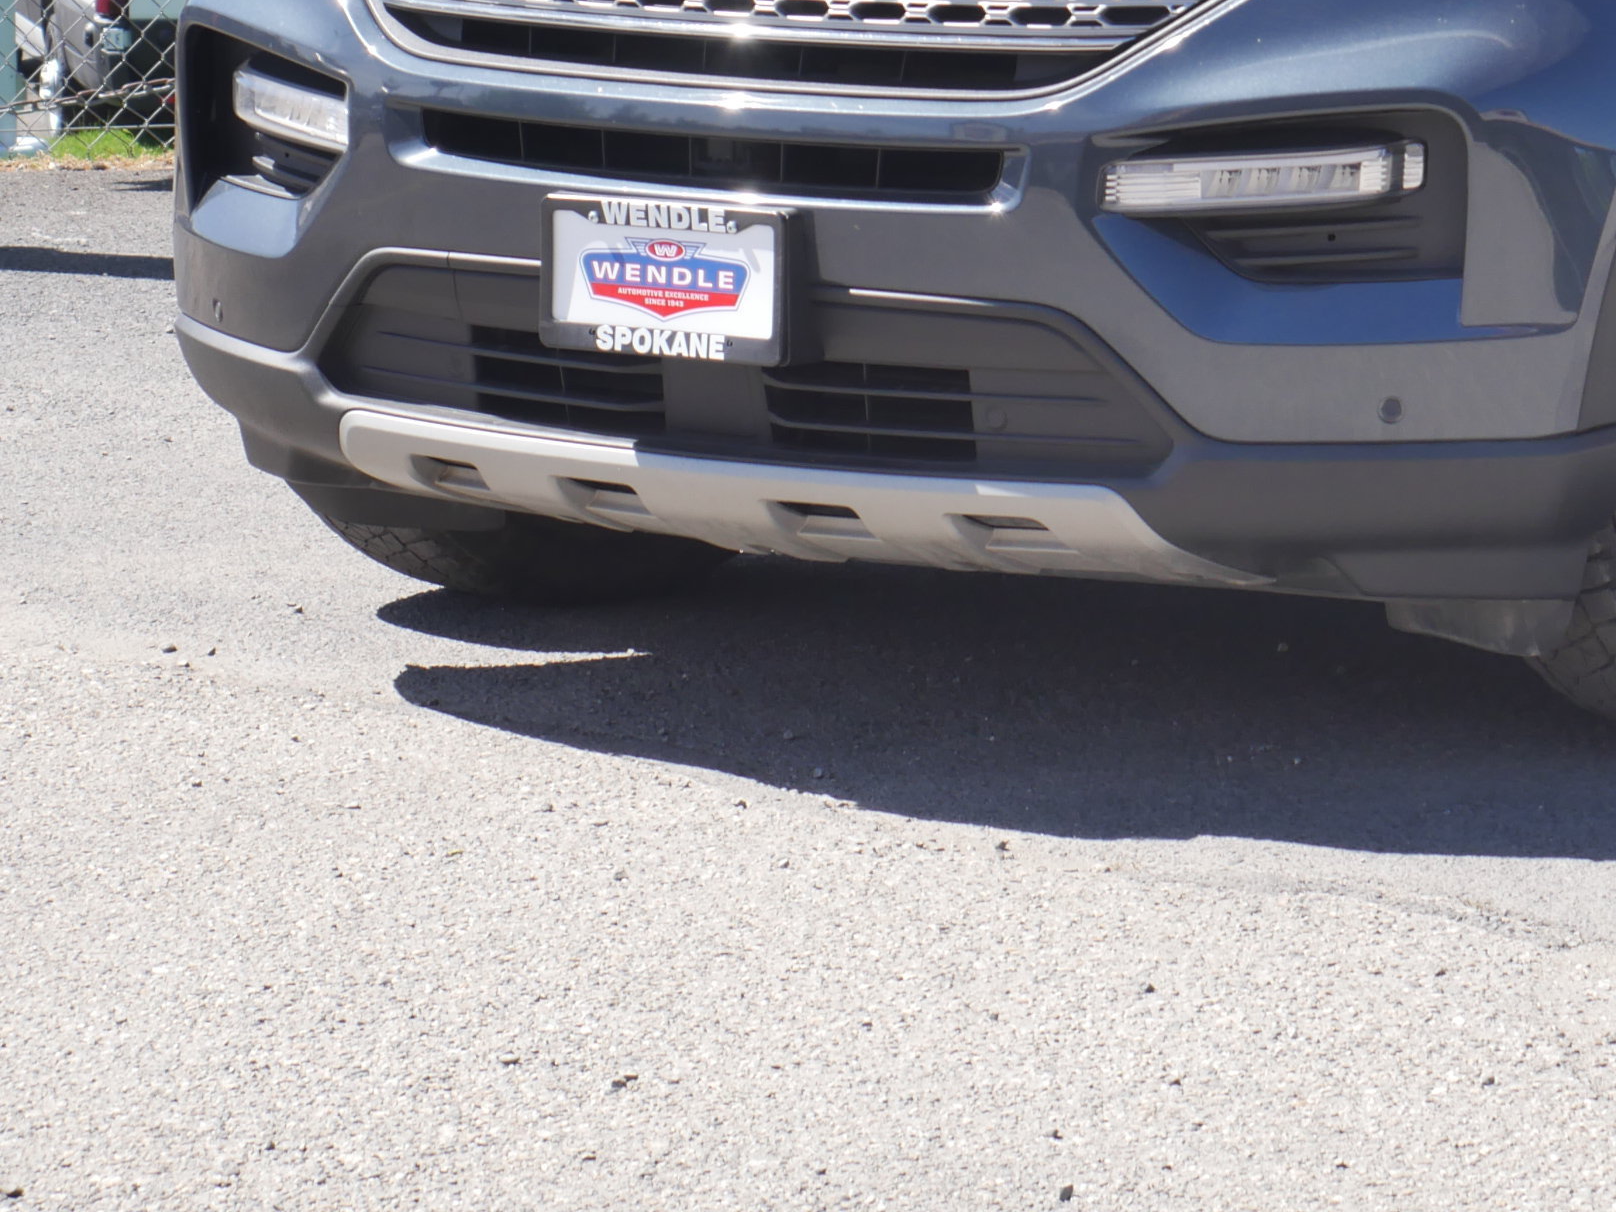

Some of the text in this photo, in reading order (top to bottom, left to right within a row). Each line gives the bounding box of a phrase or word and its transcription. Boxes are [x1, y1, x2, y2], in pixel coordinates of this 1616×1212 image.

[601, 200, 726, 234] WENDLE
[591, 260, 734, 290] WENDLE
[617, 287, 710, 302] AUTOMOTIVE EXCELLENCE
[644, 297, 685, 308] SINCE 1943
[595, 324, 726, 361] SPOKANE
